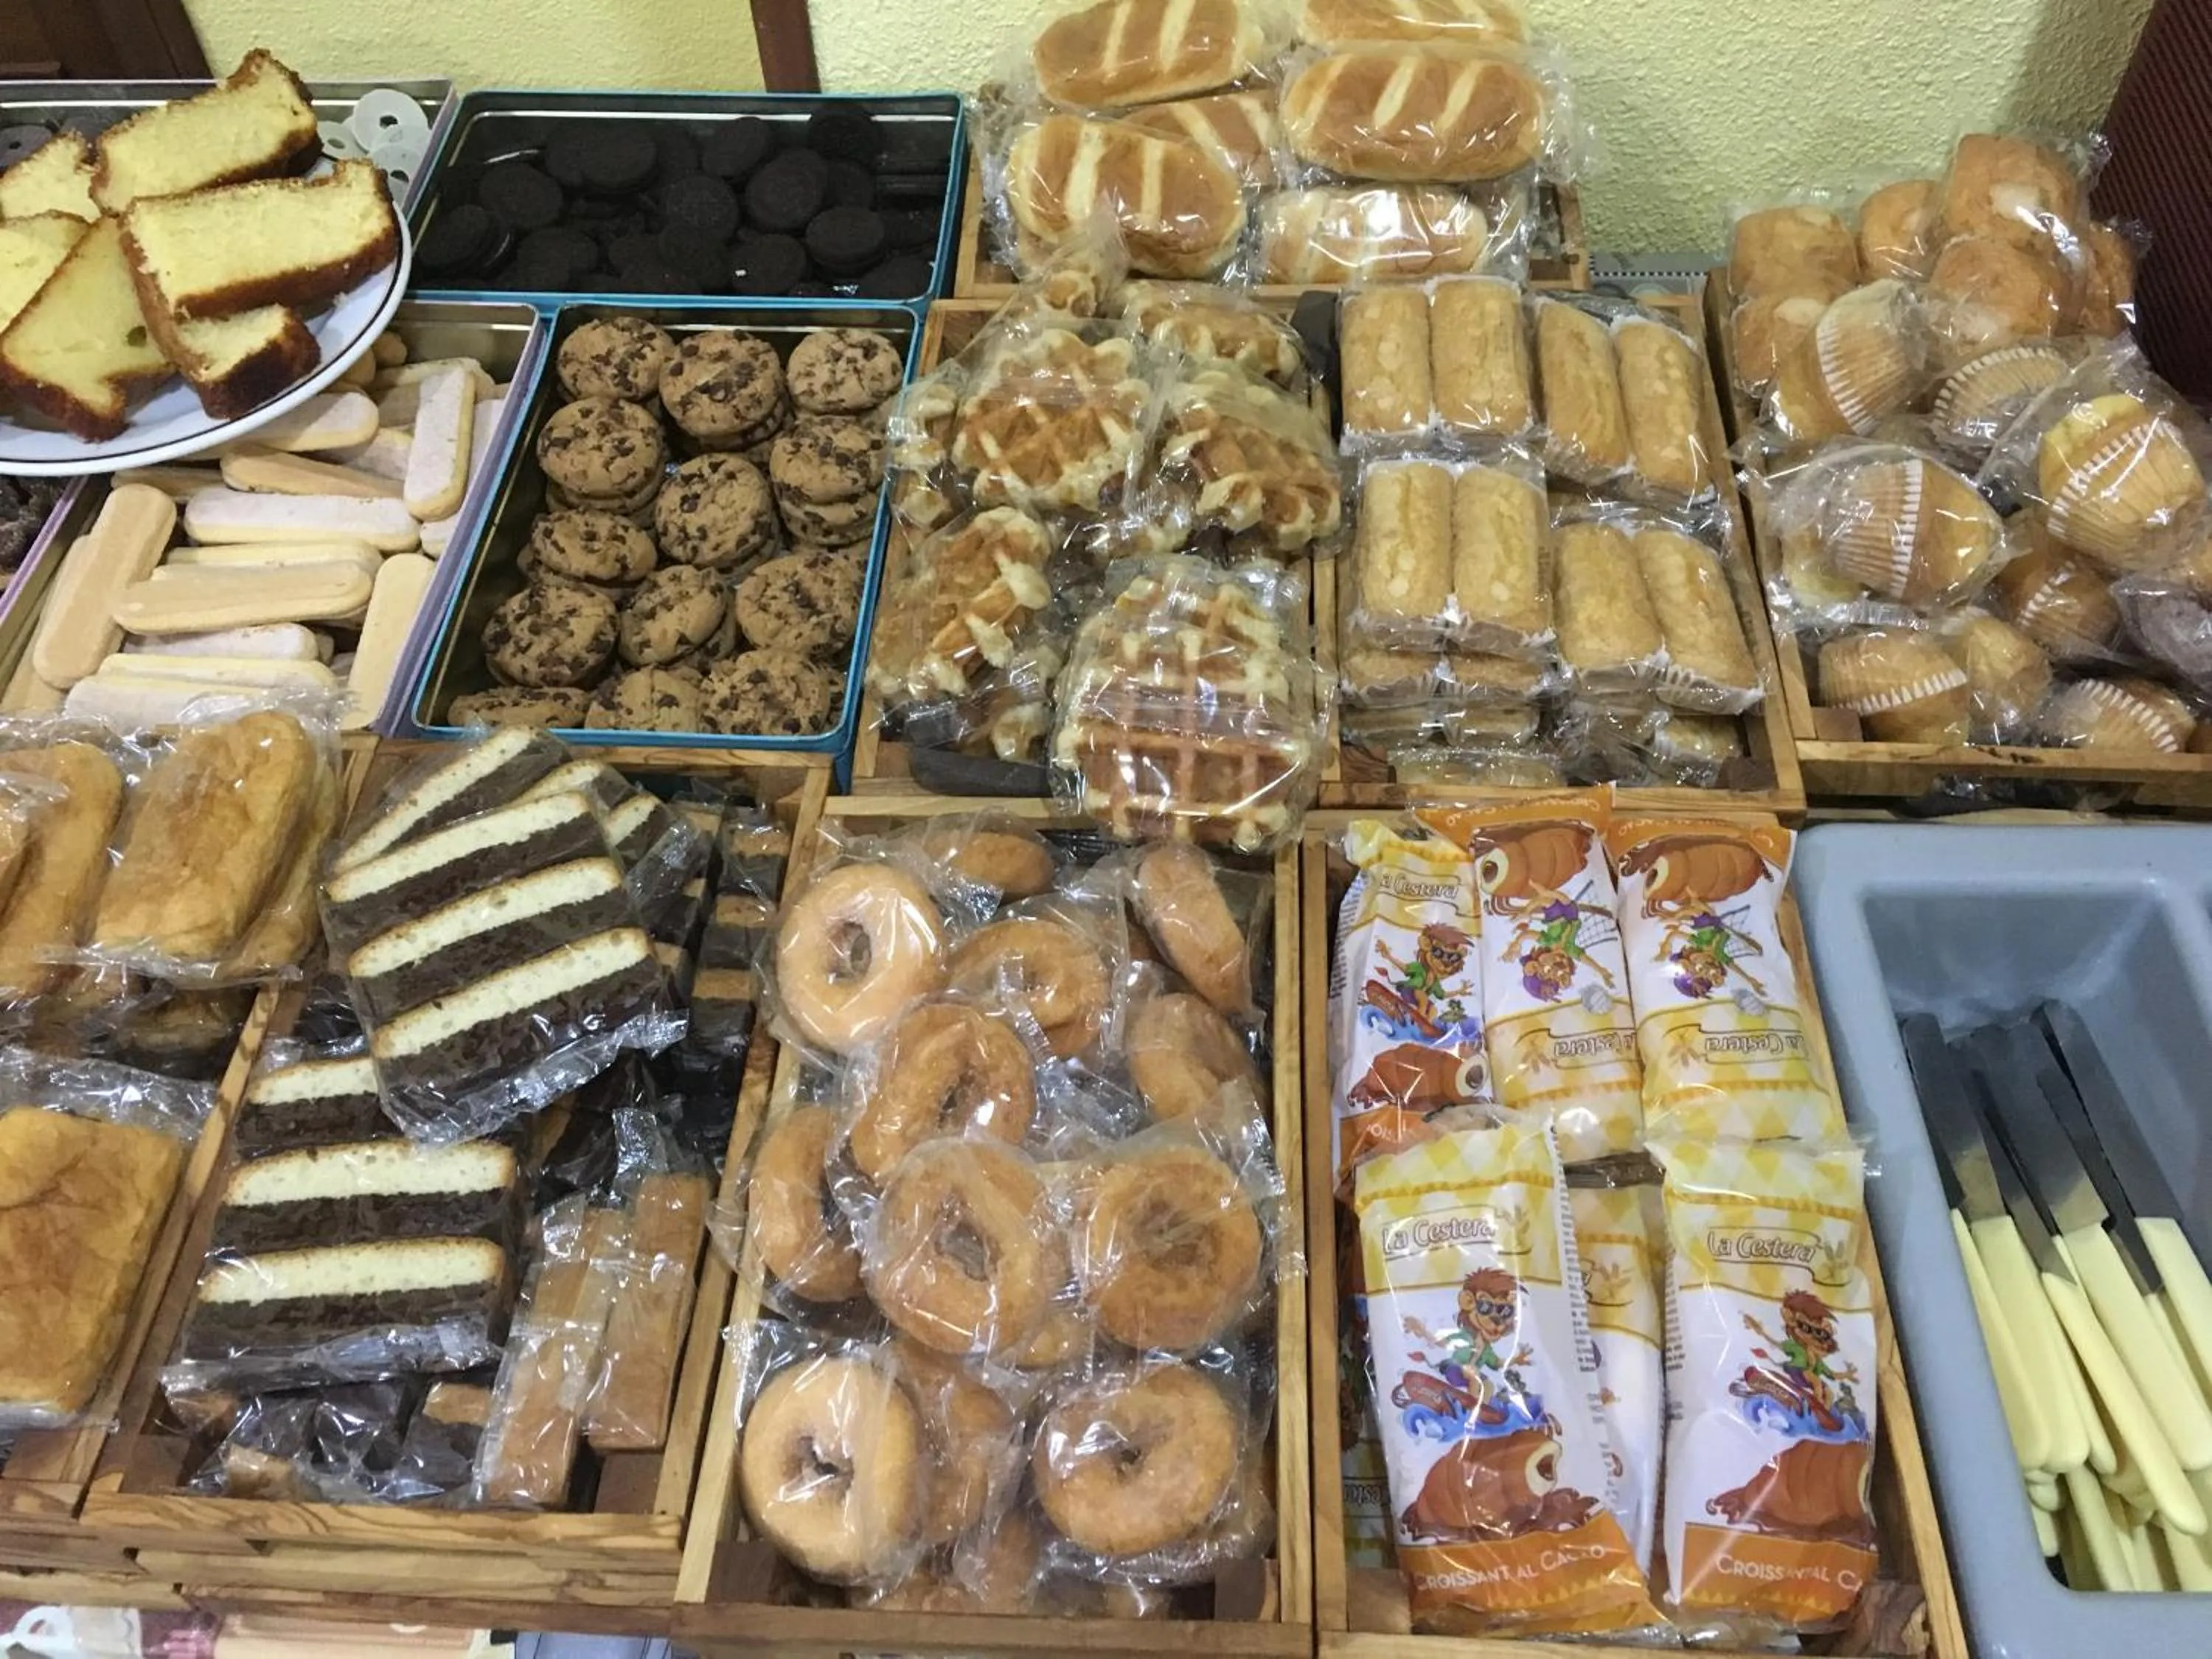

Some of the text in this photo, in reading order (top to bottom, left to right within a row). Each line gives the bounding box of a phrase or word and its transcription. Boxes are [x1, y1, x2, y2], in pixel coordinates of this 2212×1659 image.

[1394, 873, 1459, 899] Cestera
[1705, 1033, 1784, 1054] Cestera
[1382, 1217, 1495, 1255] La Cestera
[1707, 1231, 1816, 1263] La Cestera
[1416, 1564, 1511, 1590] CROISSANT
[1517, 1564, 1540, 1578] AL
